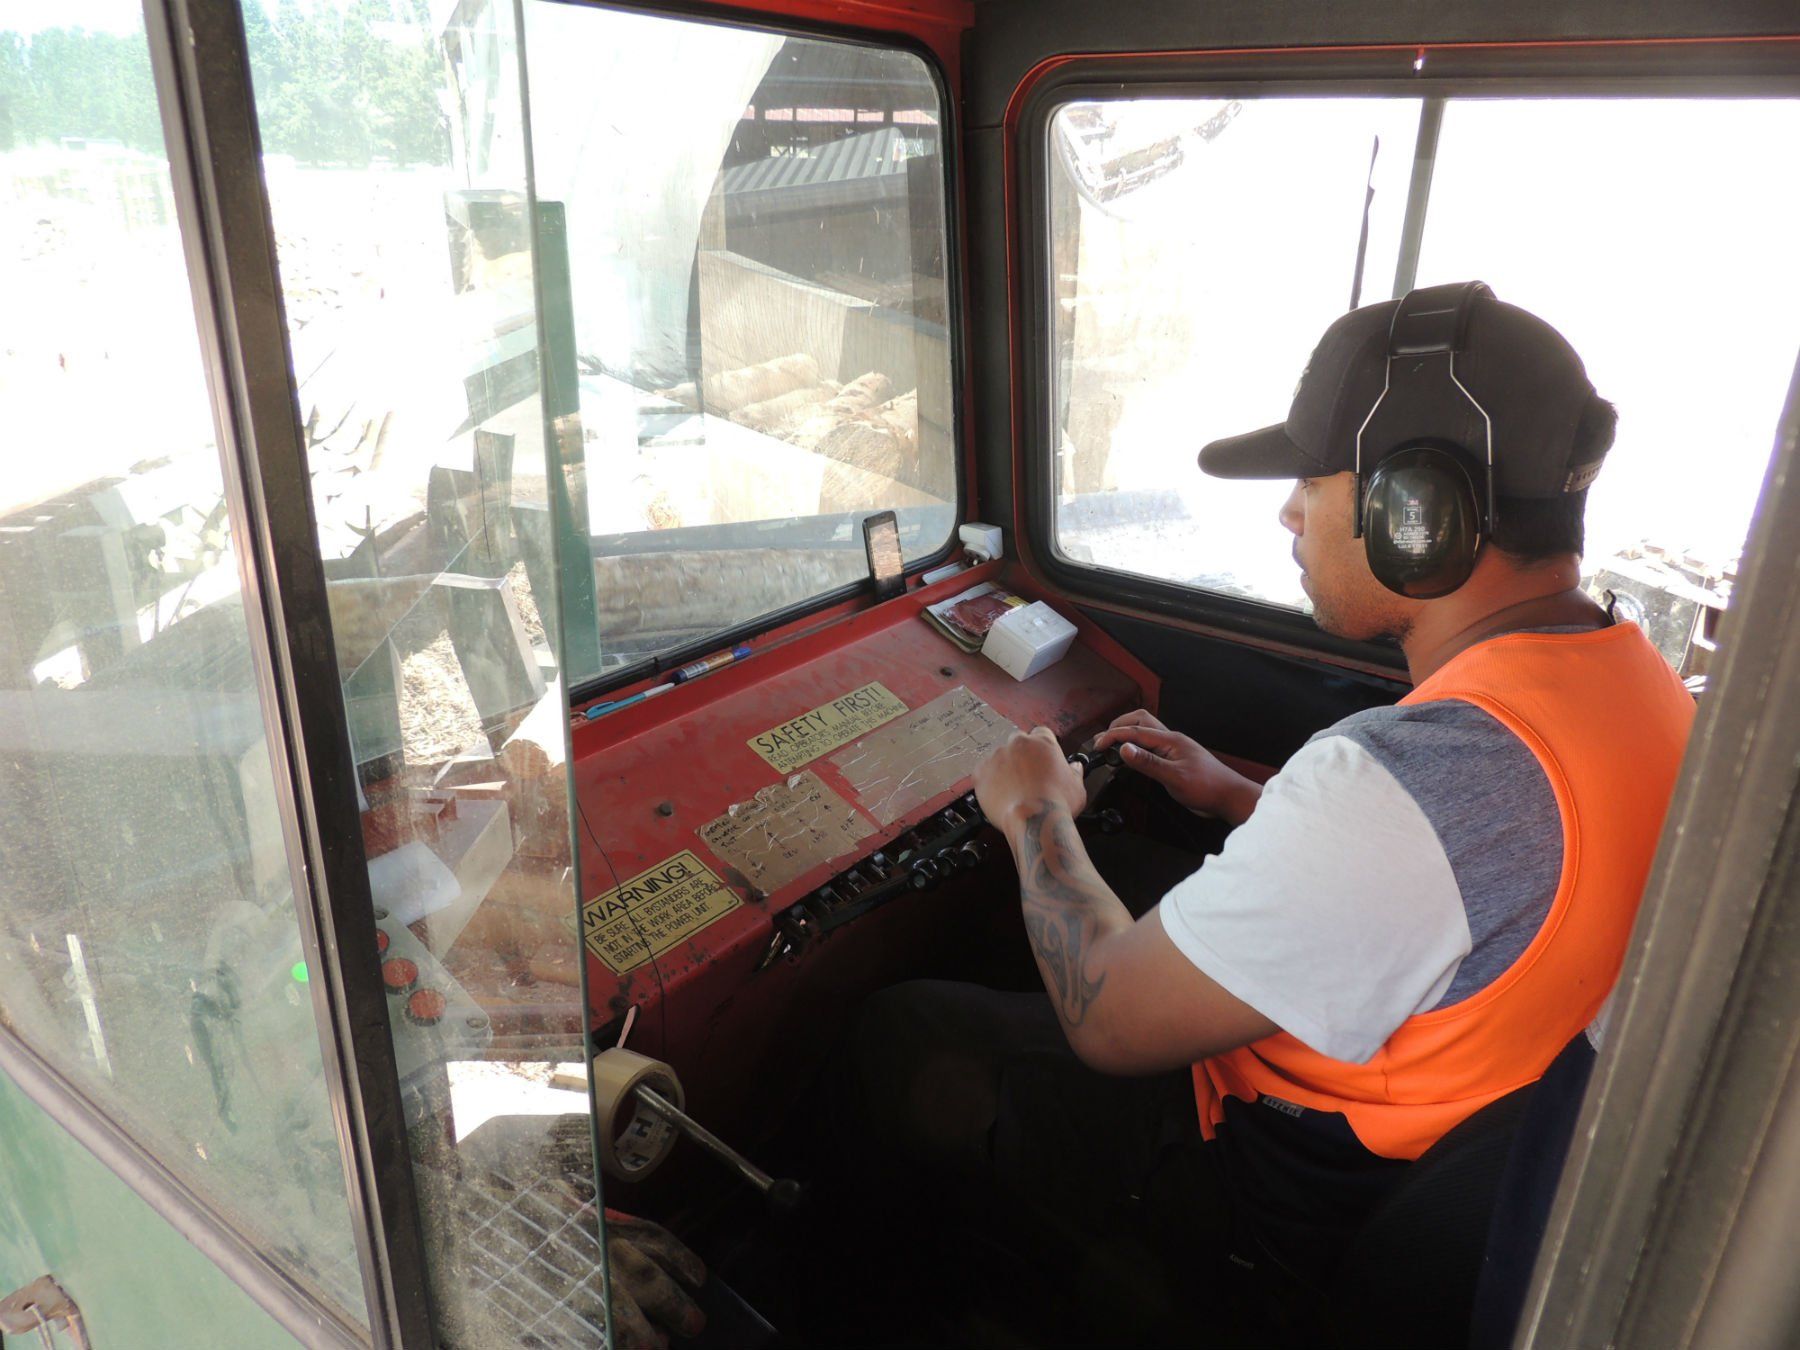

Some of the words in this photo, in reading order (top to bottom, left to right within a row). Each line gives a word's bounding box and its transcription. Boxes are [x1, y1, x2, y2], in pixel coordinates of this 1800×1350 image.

[1409, 511, 1416, 520] 5
[756, 711, 828, 754] SAFETY
[833, 686, 886, 717] FIRST!
[821, 737, 833, 747] TO
[833, 724, 861, 740] OPERATE
[861, 702, 885, 717] BEFORE
[583, 862, 692, 928] WARNING!
[593, 933, 607, 945] BE
[606, 921, 630, 937] SURE
[629, 911, 646, 923] ALL
[643, 886, 690, 916] BYSTANDERS
[689, 878, 705, 890] ARE
[603, 940, 623, 954] NOT
[621, 934, 633, 943] IN
[632, 922, 649, 937] THE
[648, 910, 673, 928] WORK
[672, 899, 695, 915] AREA
[691, 882, 719, 902] BEFORE
[613, 939, 652, 964] STARTING
[651, 928, 667, 941] THE
[665, 912, 694, 932] POWER
